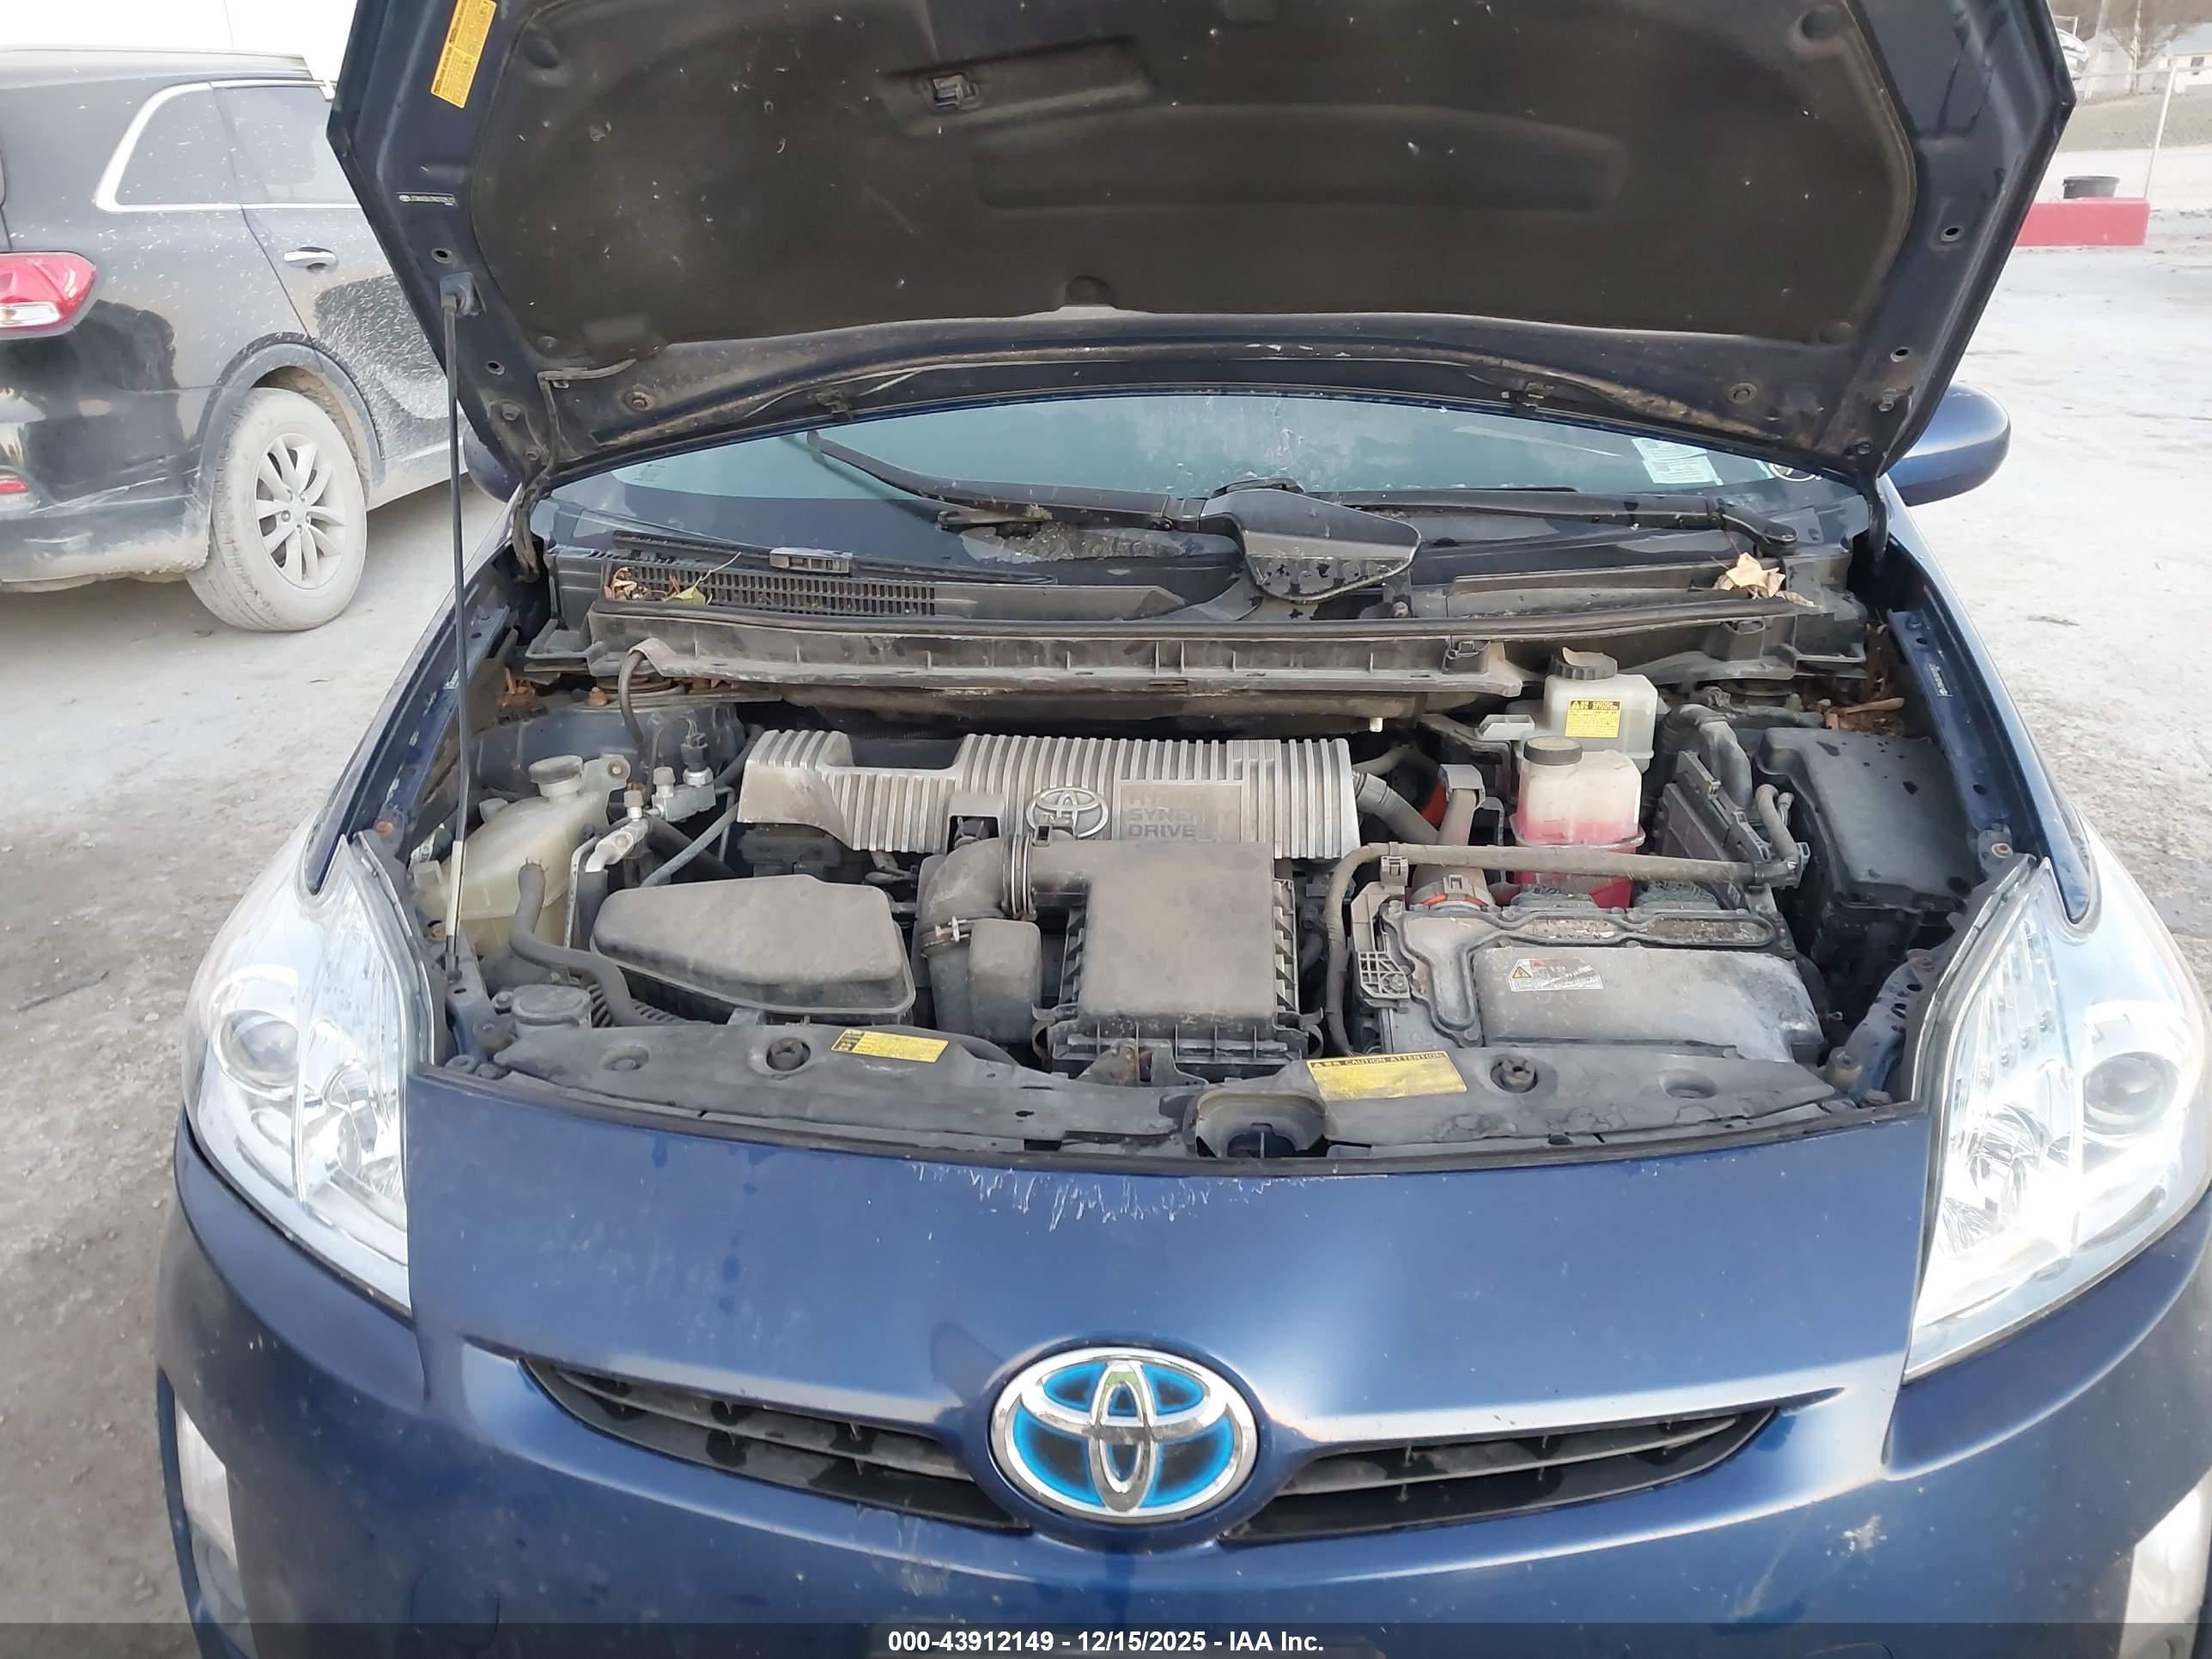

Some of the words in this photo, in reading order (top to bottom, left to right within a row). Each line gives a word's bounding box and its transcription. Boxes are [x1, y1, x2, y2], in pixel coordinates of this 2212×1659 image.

[1127, 823, 1196, 837] DRIVE
[1345, 1058, 1387, 1066] CAUTION
[1389, 1052, 1443, 1063] ATTENTION
